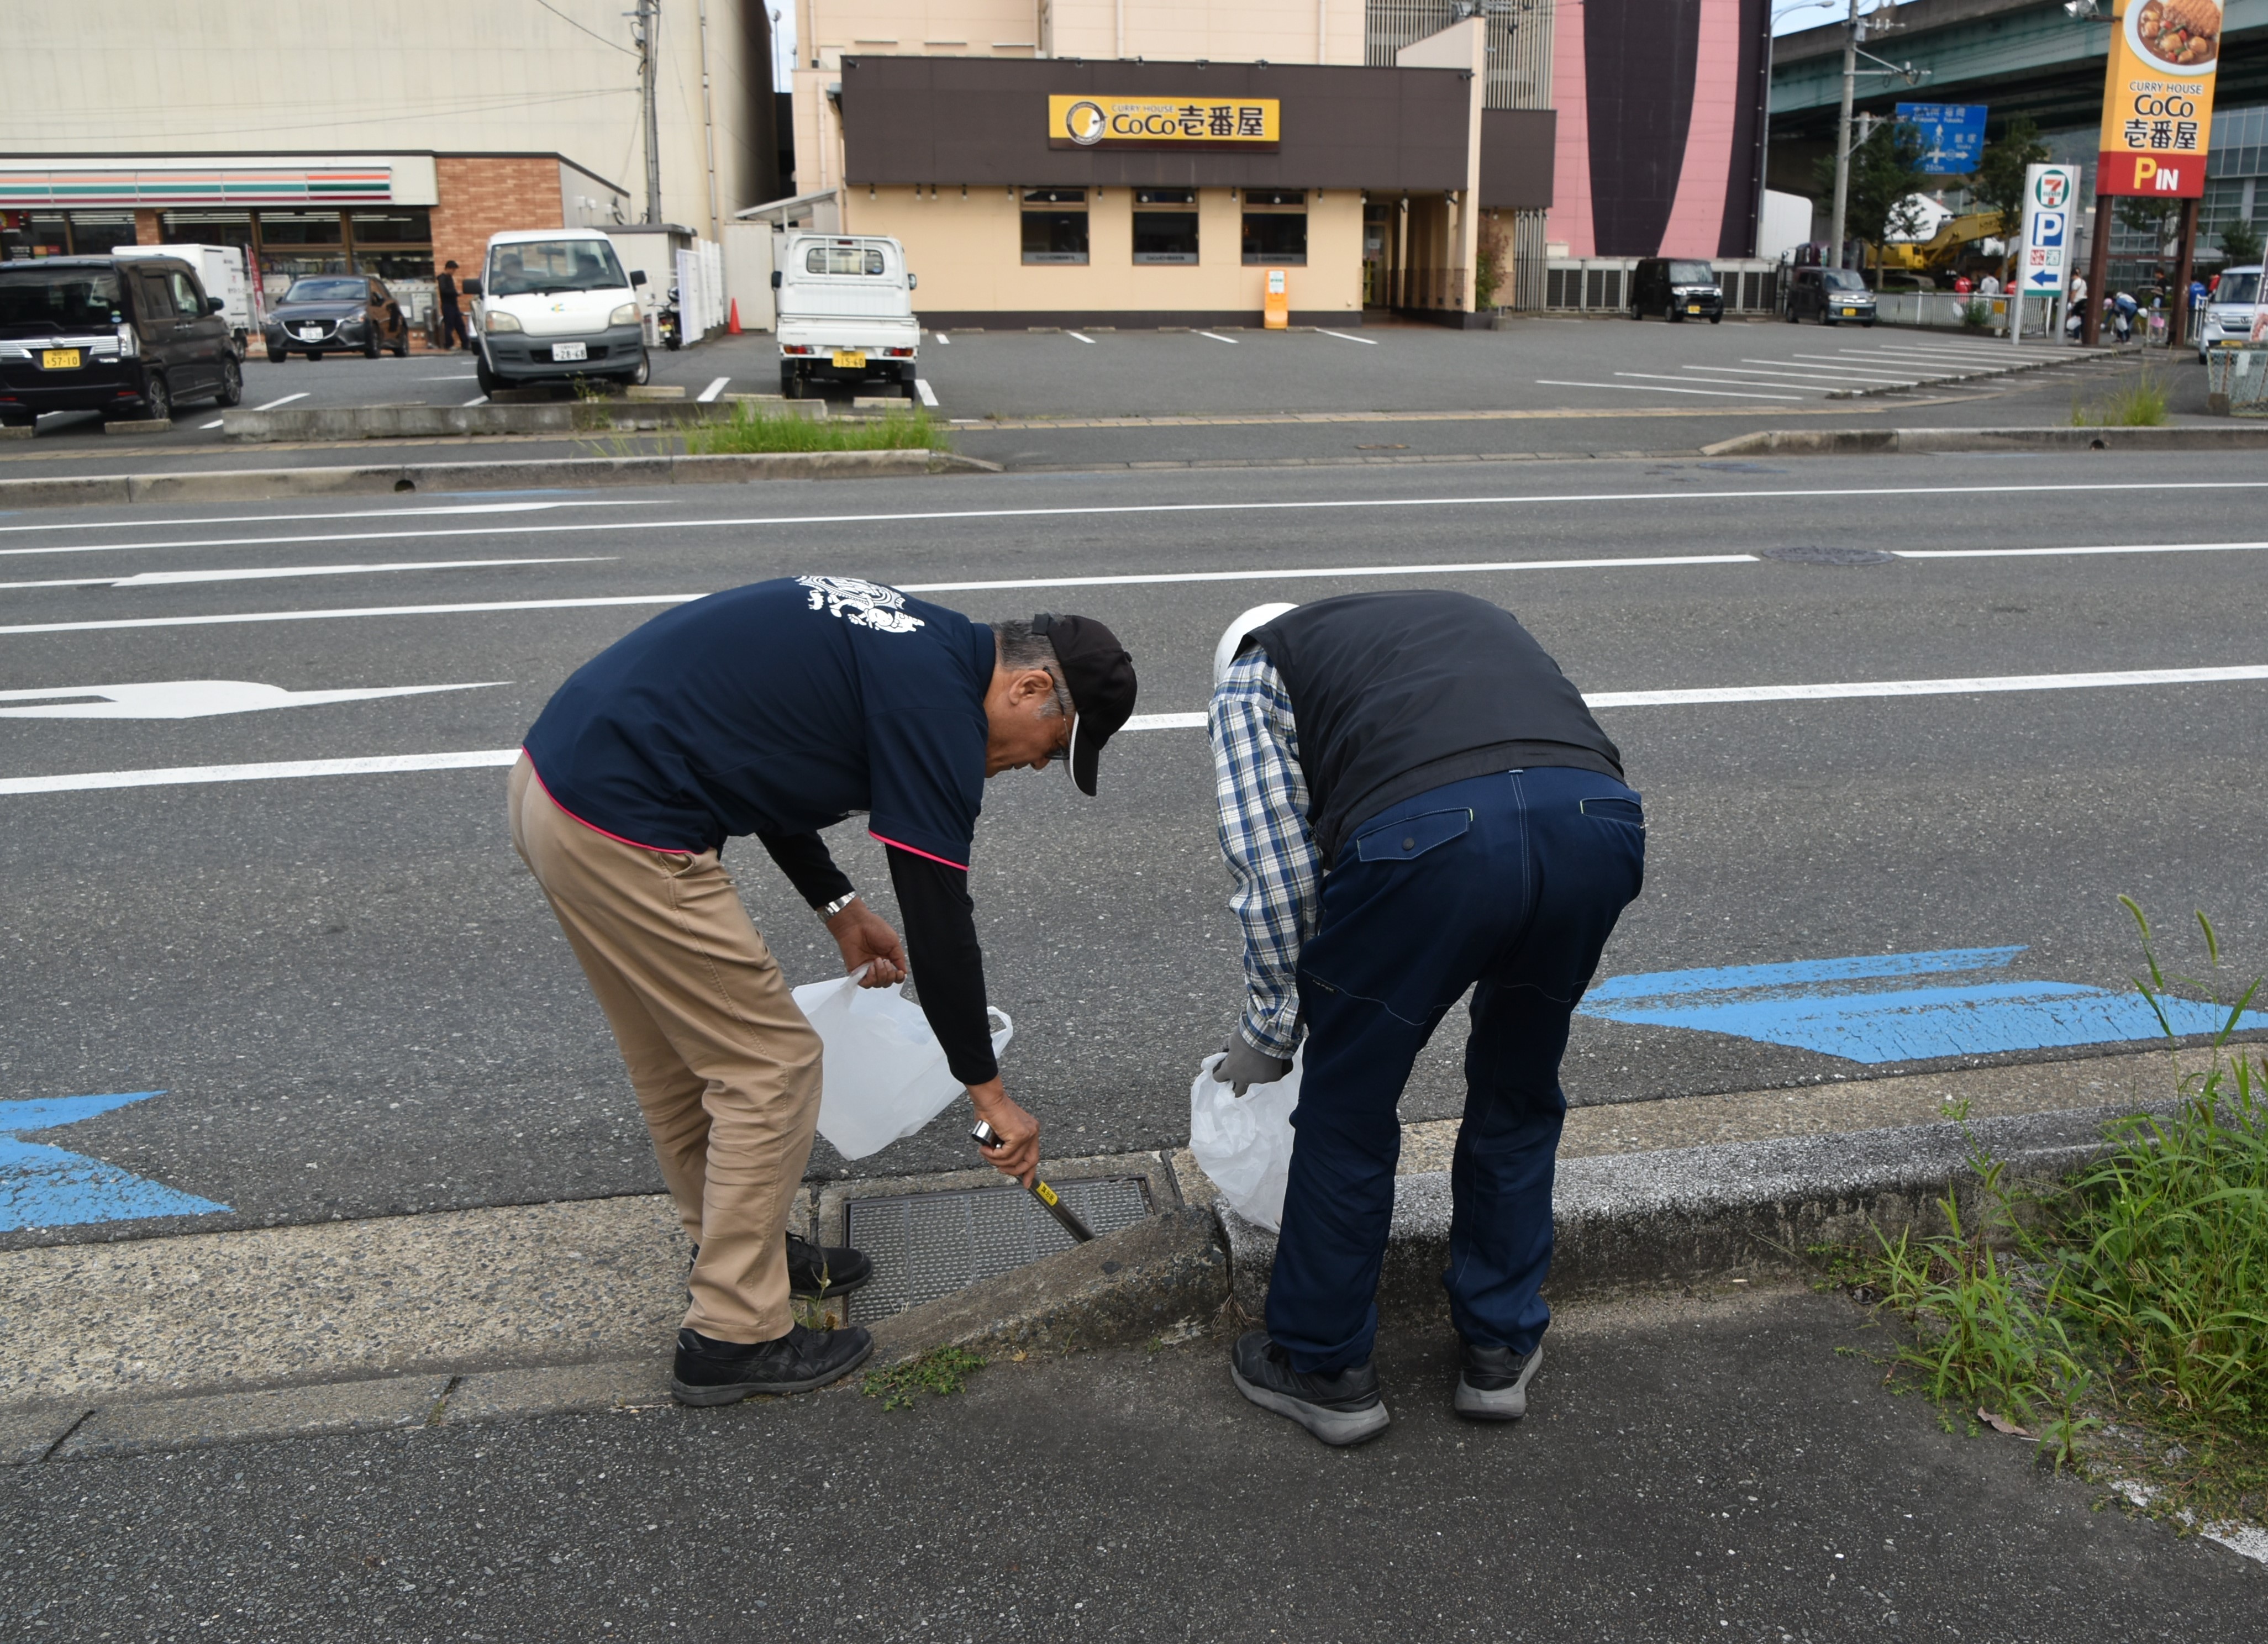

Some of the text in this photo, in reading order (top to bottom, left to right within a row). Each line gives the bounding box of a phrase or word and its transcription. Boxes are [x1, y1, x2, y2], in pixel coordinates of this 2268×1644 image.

[2130, 82, 2202, 94] CURRY HOUSE
[2134, 94, 2193, 118] CoCo
[2124, 119, 2198, 150] 壱番屋
[2035, 213, 2062, 246] P
